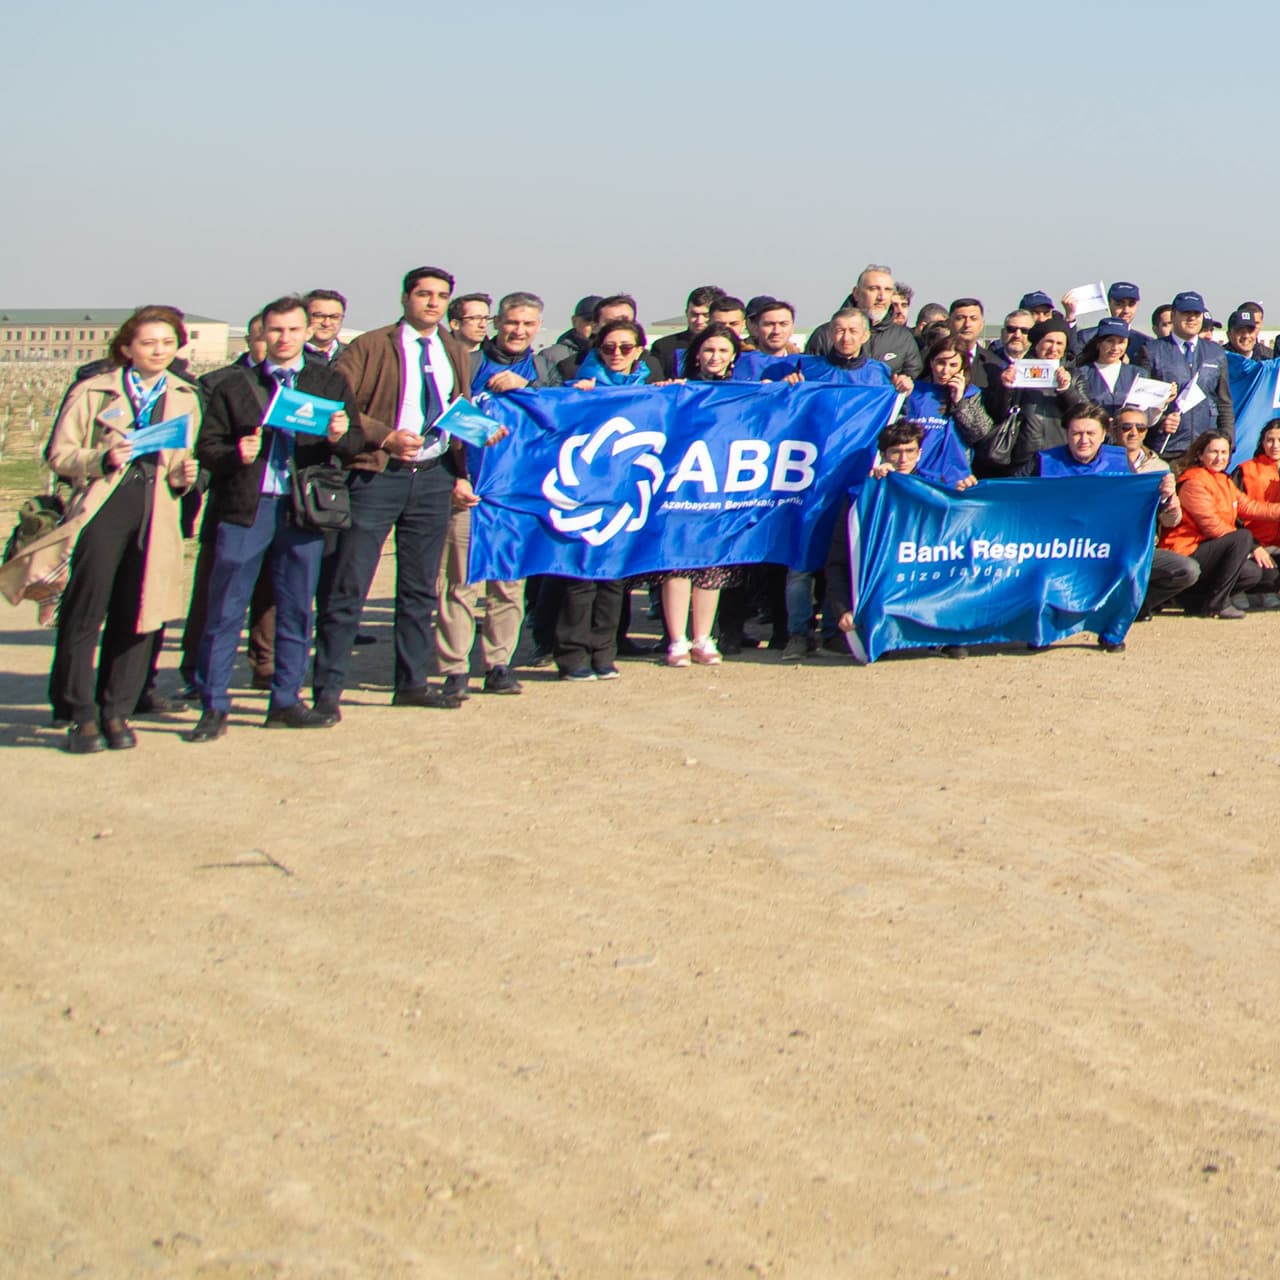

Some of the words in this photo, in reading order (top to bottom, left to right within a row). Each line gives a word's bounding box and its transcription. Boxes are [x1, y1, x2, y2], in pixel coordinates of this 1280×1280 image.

[665, 439, 819, 494] ABB
[662, 500, 722, 512] Azərbaycan
[897, 539, 966, 564] Bank
[971, 537, 1112, 564] Respublika
